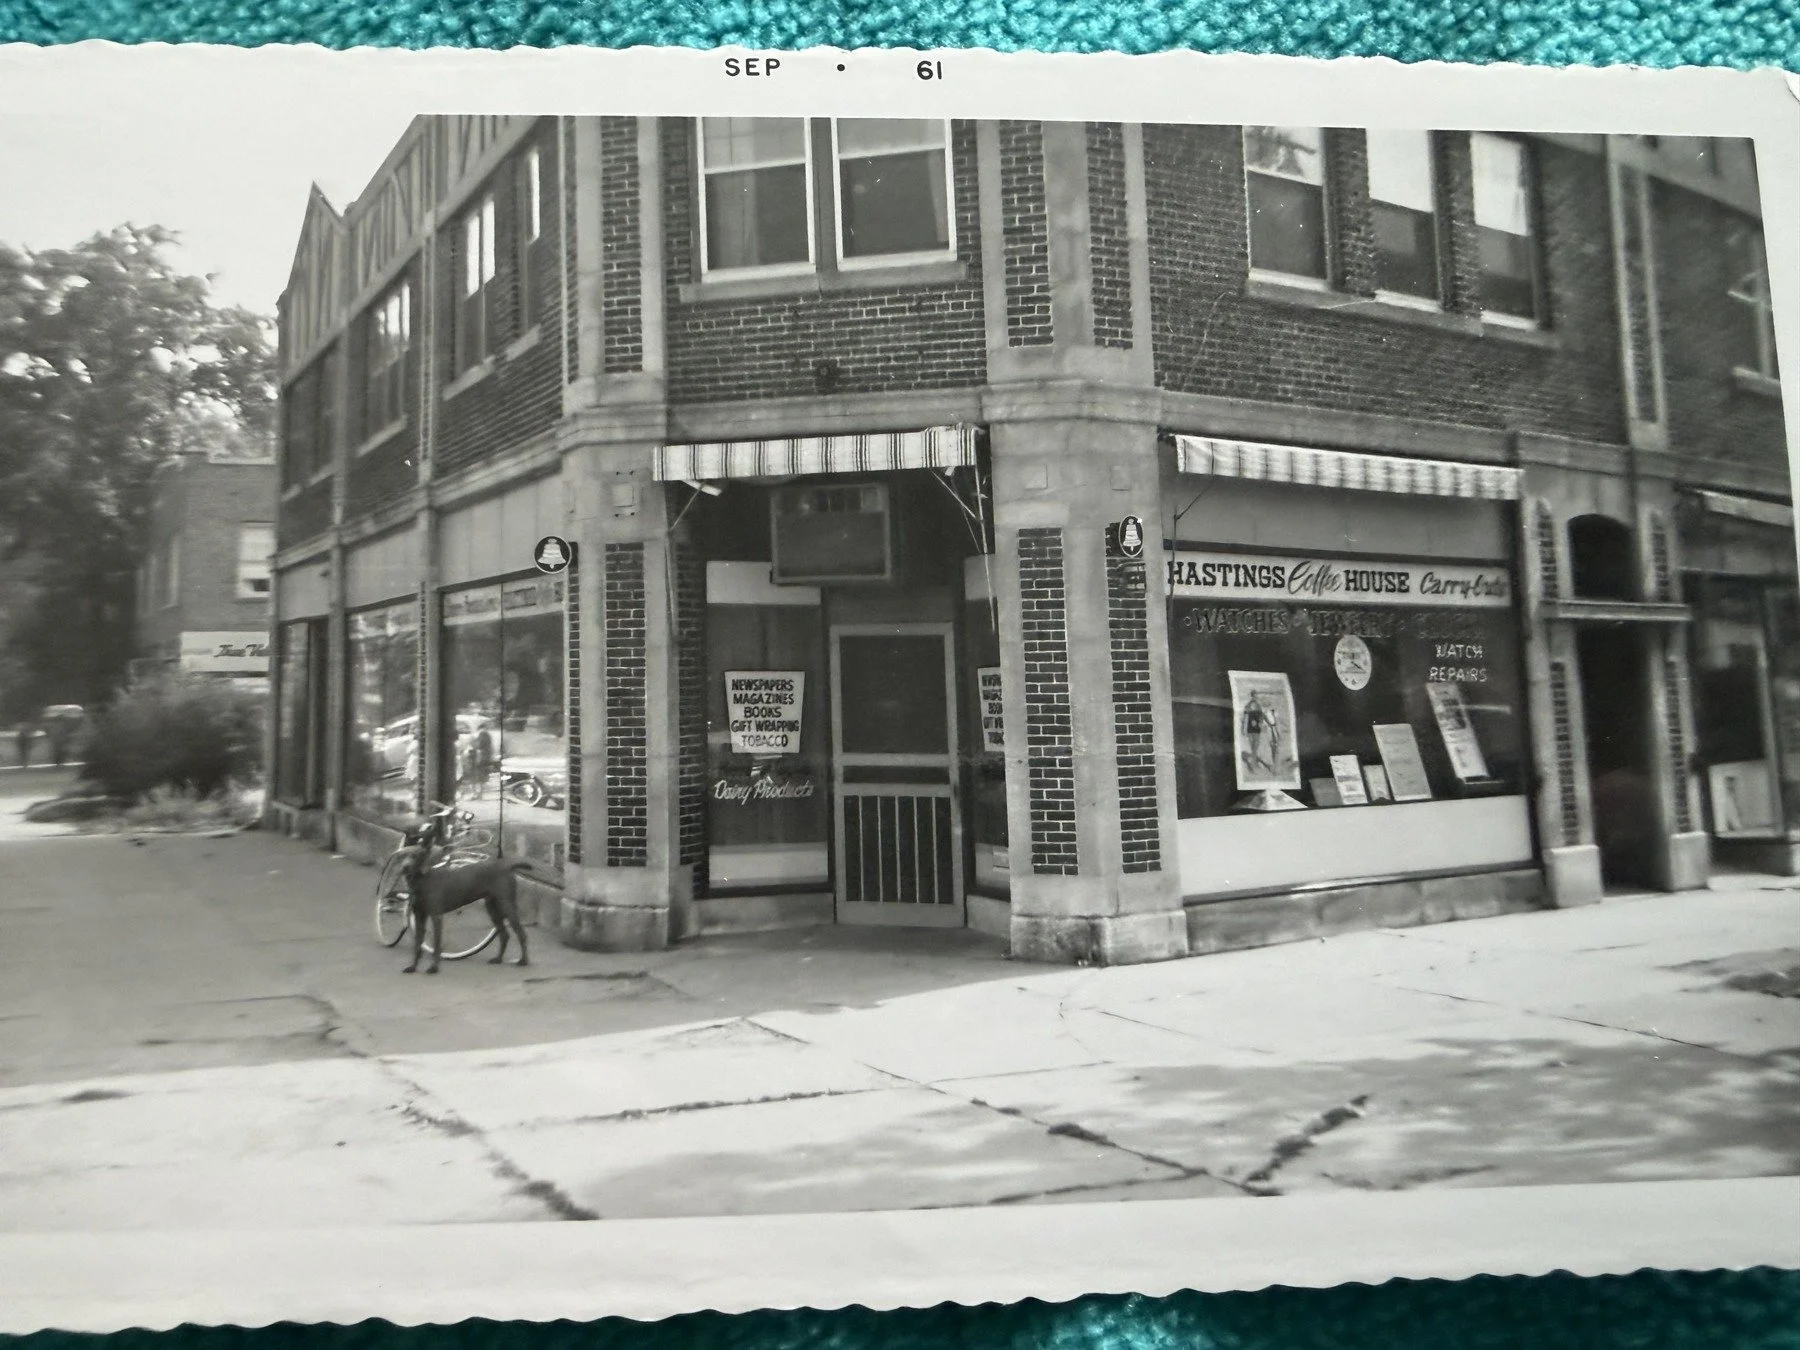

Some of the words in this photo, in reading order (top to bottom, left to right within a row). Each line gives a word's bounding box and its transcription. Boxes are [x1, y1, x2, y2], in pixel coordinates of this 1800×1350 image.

[725, 58, 781, 77] SEP
[916, 60, 943, 80] 61
[1167, 561, 1286, 589] HASTINGS
[1288, 560, 1342, 597] Coffee
[1344, 569, 1410, 593] HOUSE
[1435, 643, 1483, 659] WATCH
[1428, 666, 1488, 682] REPAIRS
[731, 679, 794, 691] NEWSPAPERS
[733, 693, 795, 705] MAGAZINES
[743, 706, 782, 718] BOOKS
[731, 720, 752, 732] GIFT
[755, 720, 800, 732] WRAPPING
[741, 734, 789, 747] TOBACCO
[714, 779, 751, 806] Dairy
